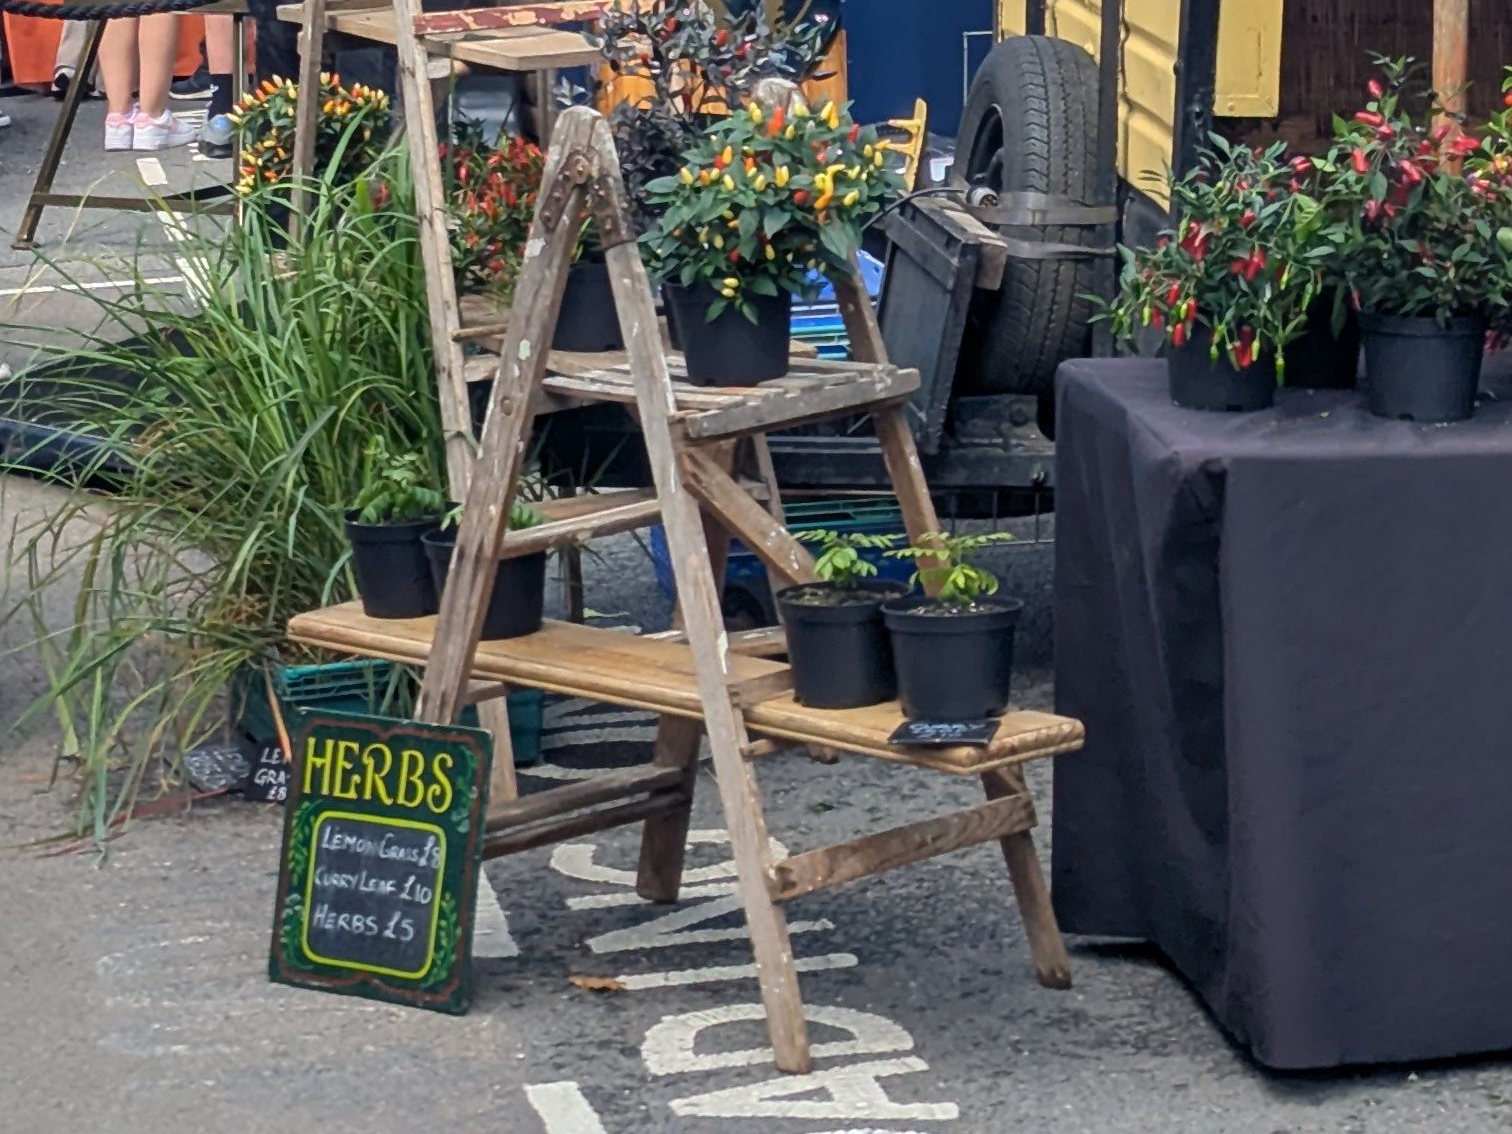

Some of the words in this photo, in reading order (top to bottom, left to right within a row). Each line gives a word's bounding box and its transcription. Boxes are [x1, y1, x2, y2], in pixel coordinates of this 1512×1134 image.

[302, 736, 454, 813] HERBS
[399, 874, 432, 904] £10
[313, 904, 379, 936] HERBS
[382, 911, 415, 942] £5
